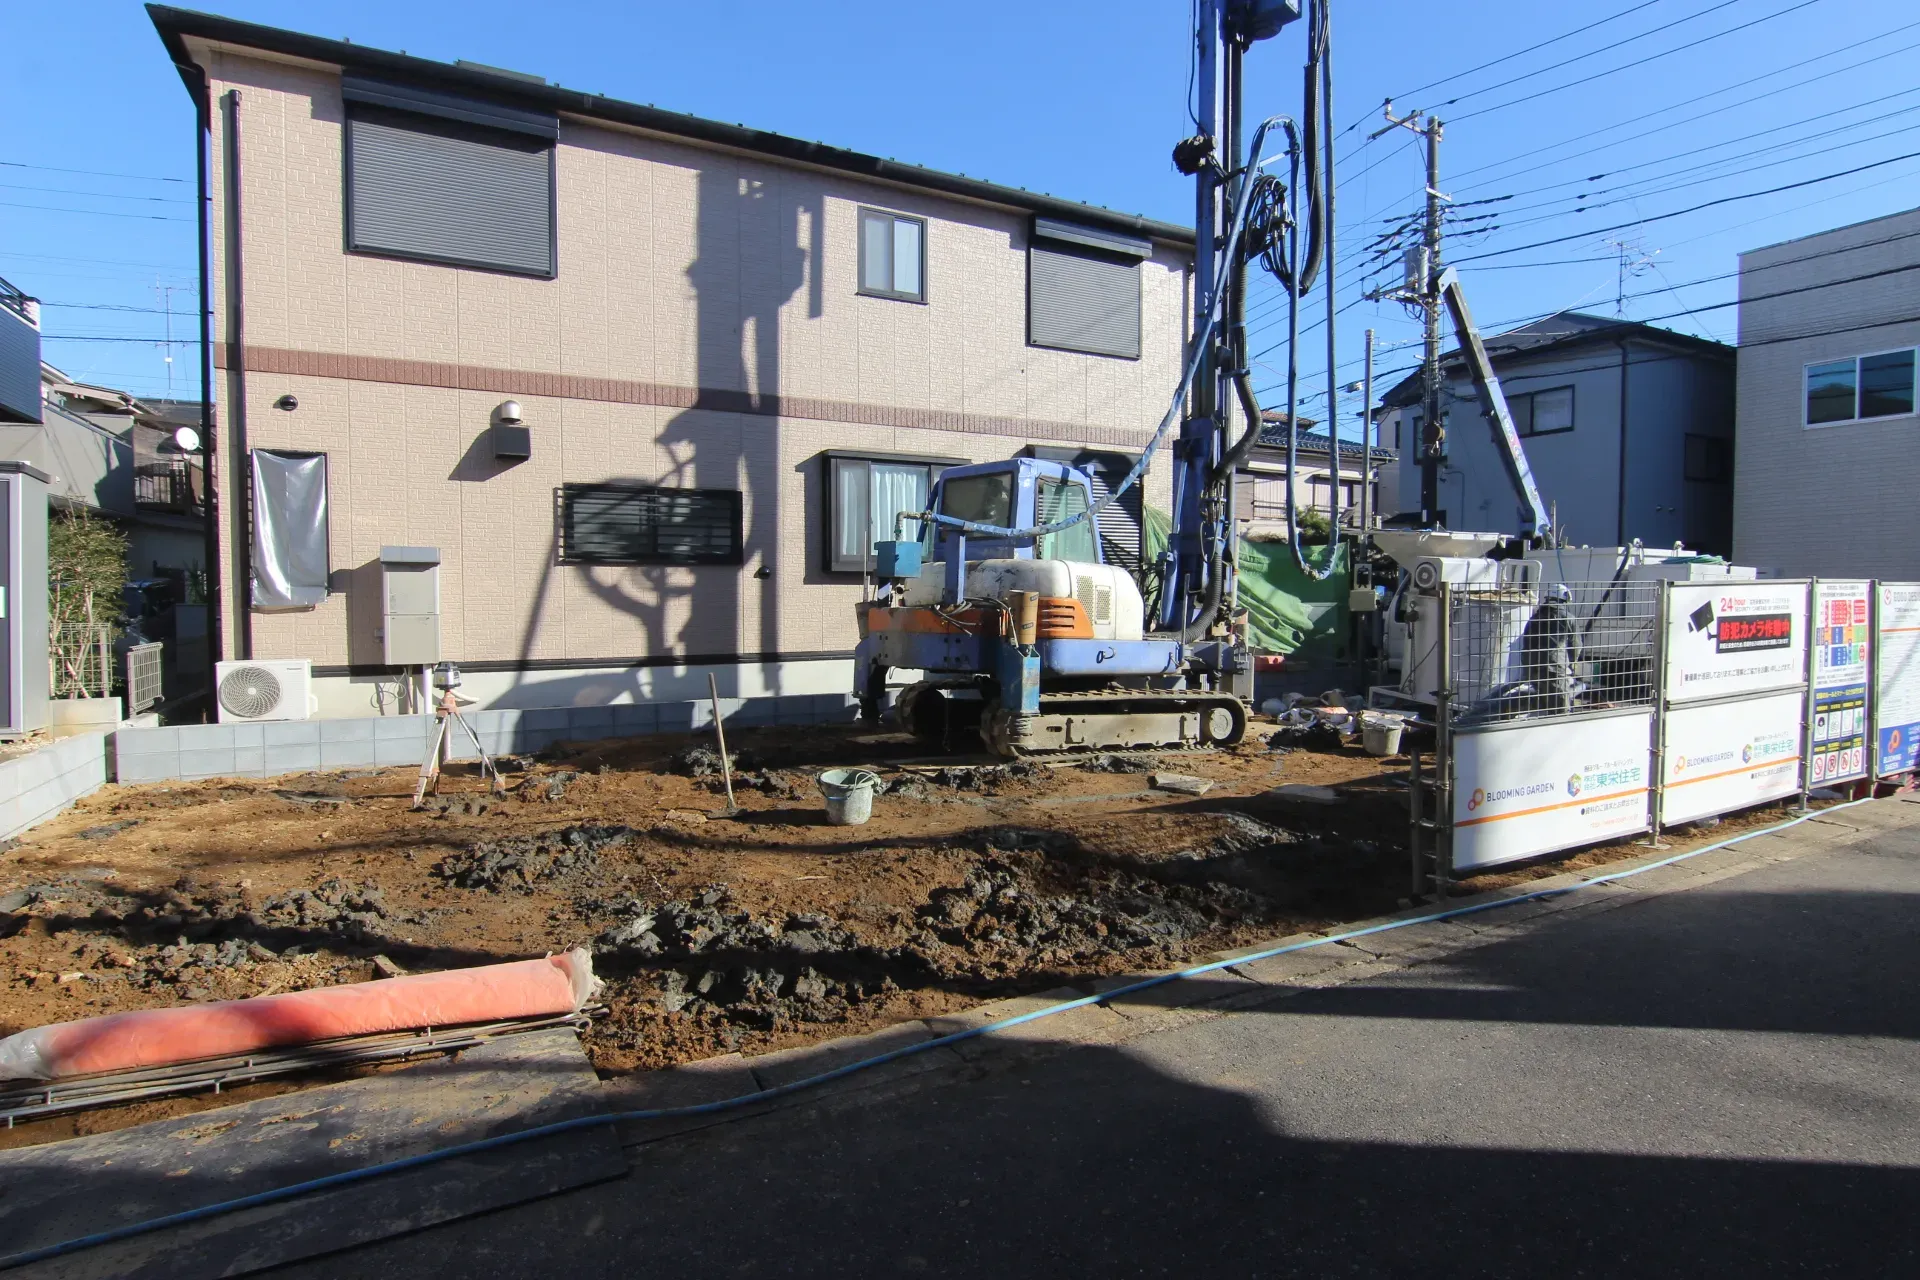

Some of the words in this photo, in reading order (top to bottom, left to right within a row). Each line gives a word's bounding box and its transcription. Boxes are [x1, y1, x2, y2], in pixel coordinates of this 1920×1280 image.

[1720, 597, 1733, 612] 24
[1720, 620, 1790, 640] 防犯カメラ作動中
[1762, 739, 1794, 756] 東栄住宅
[1687, 755, 1713, 767] BLOOMING
[1714, 751, 1734, 763] GARDEN
[1596, 768, 1640, 787] 東栄住宅
[1486, 787, 1525, 802] BLOOMING
[1526, 783, 1554, 798] GARDEN
